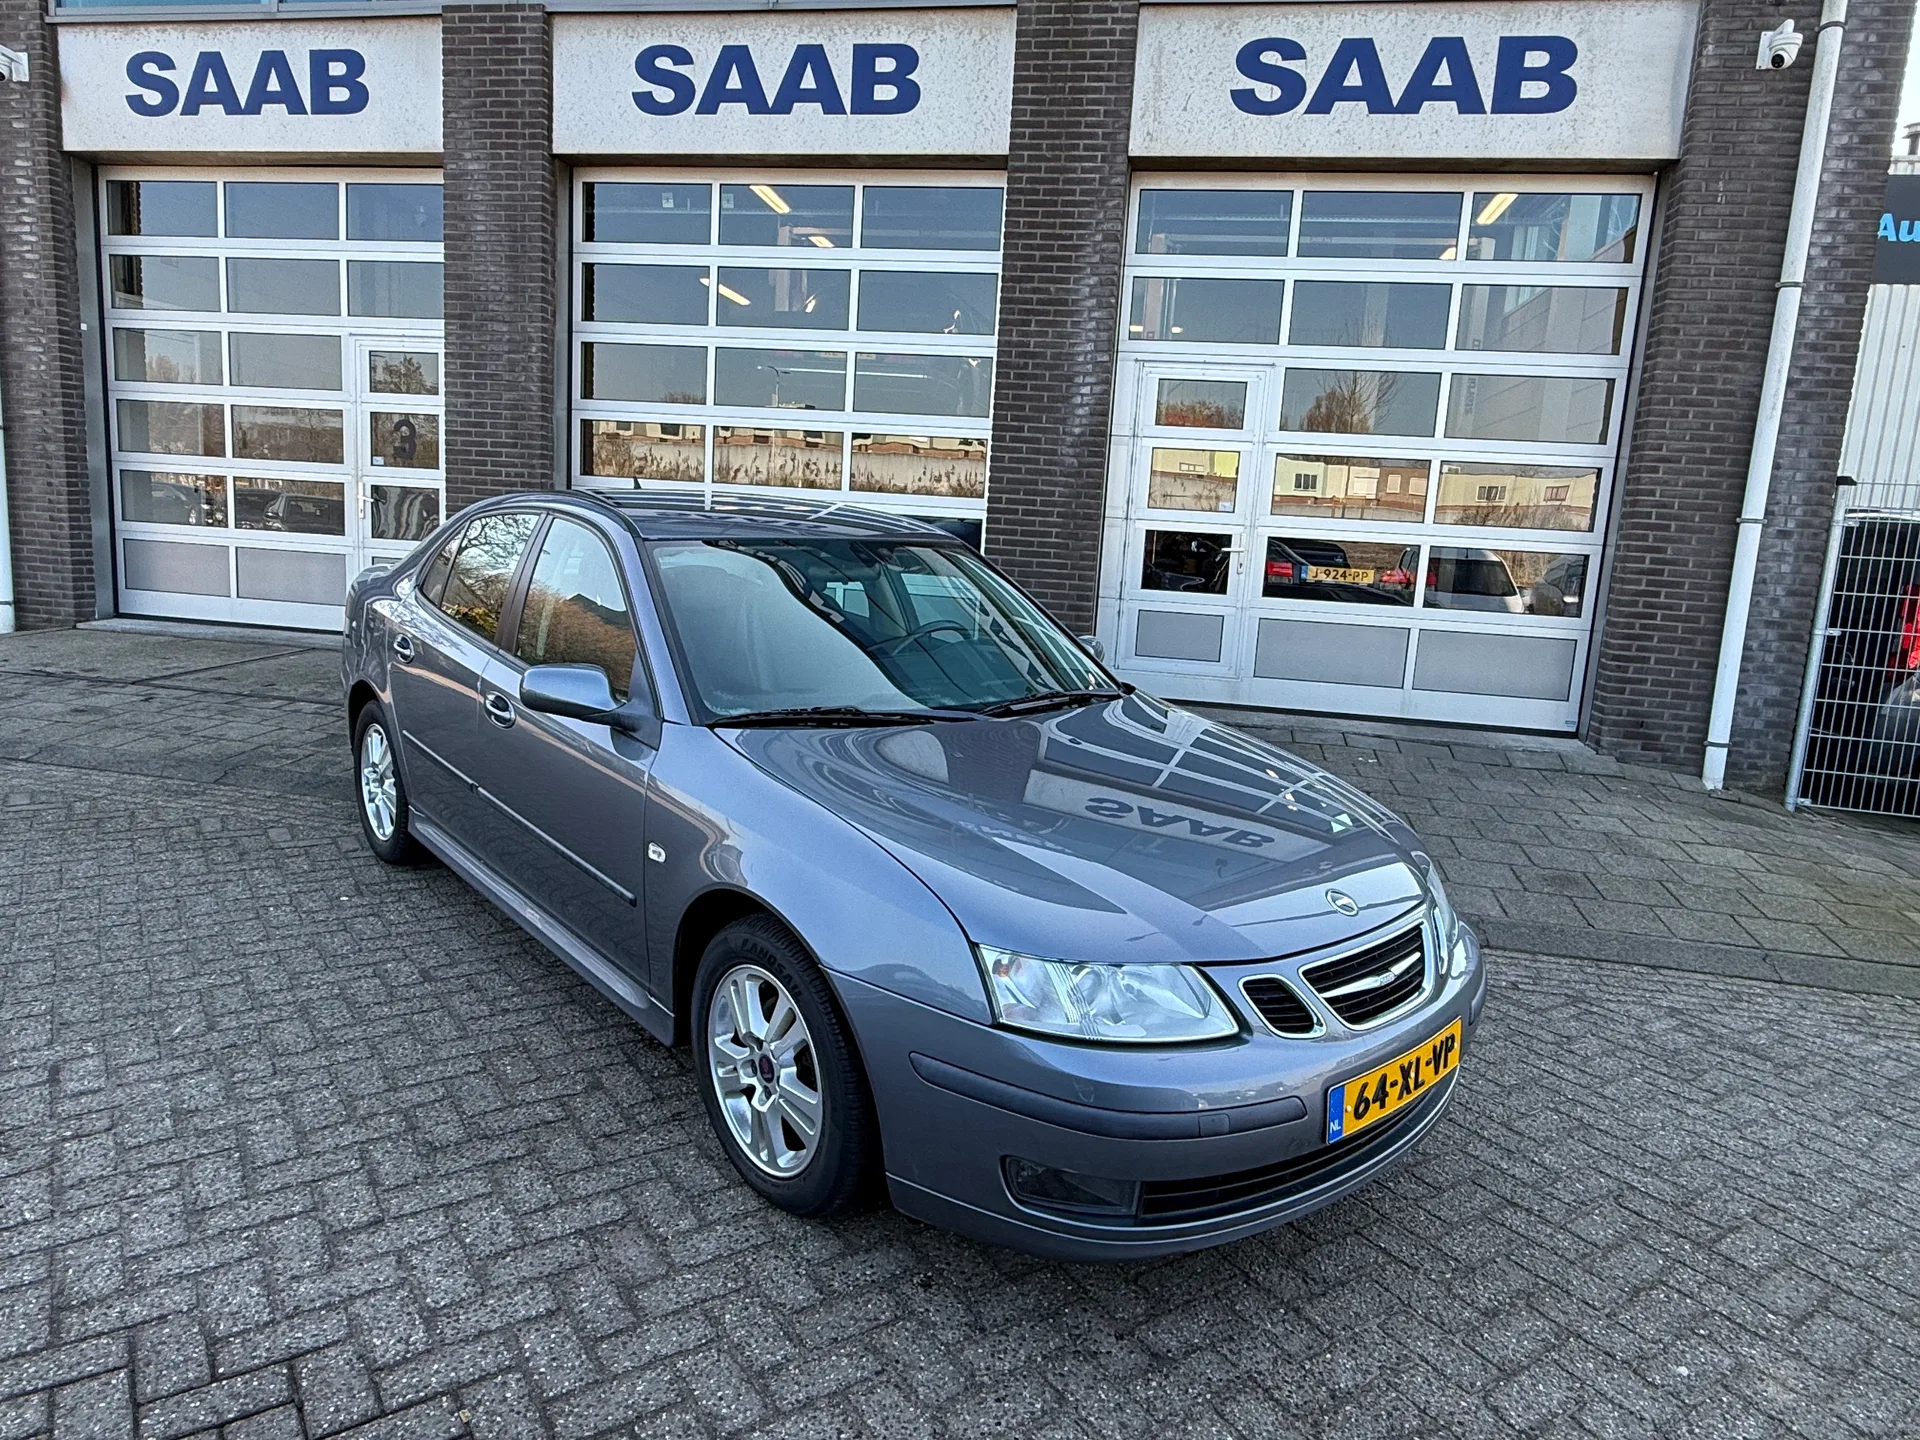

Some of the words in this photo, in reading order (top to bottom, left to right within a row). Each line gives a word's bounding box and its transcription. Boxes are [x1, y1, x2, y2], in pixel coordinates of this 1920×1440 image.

[126, 49, 369, 116] SAAB
[632, 43, 921, 116] SAAB
[1231, 35, 1577, 116] SAAB
[393, 418, 417, 460] 3
[1311, 568, 1369, 582] J-924-PP
[1329, 1119, 1341, 1134] NL
[1353, 1032, 1456, 1120] 64-XL-VP
